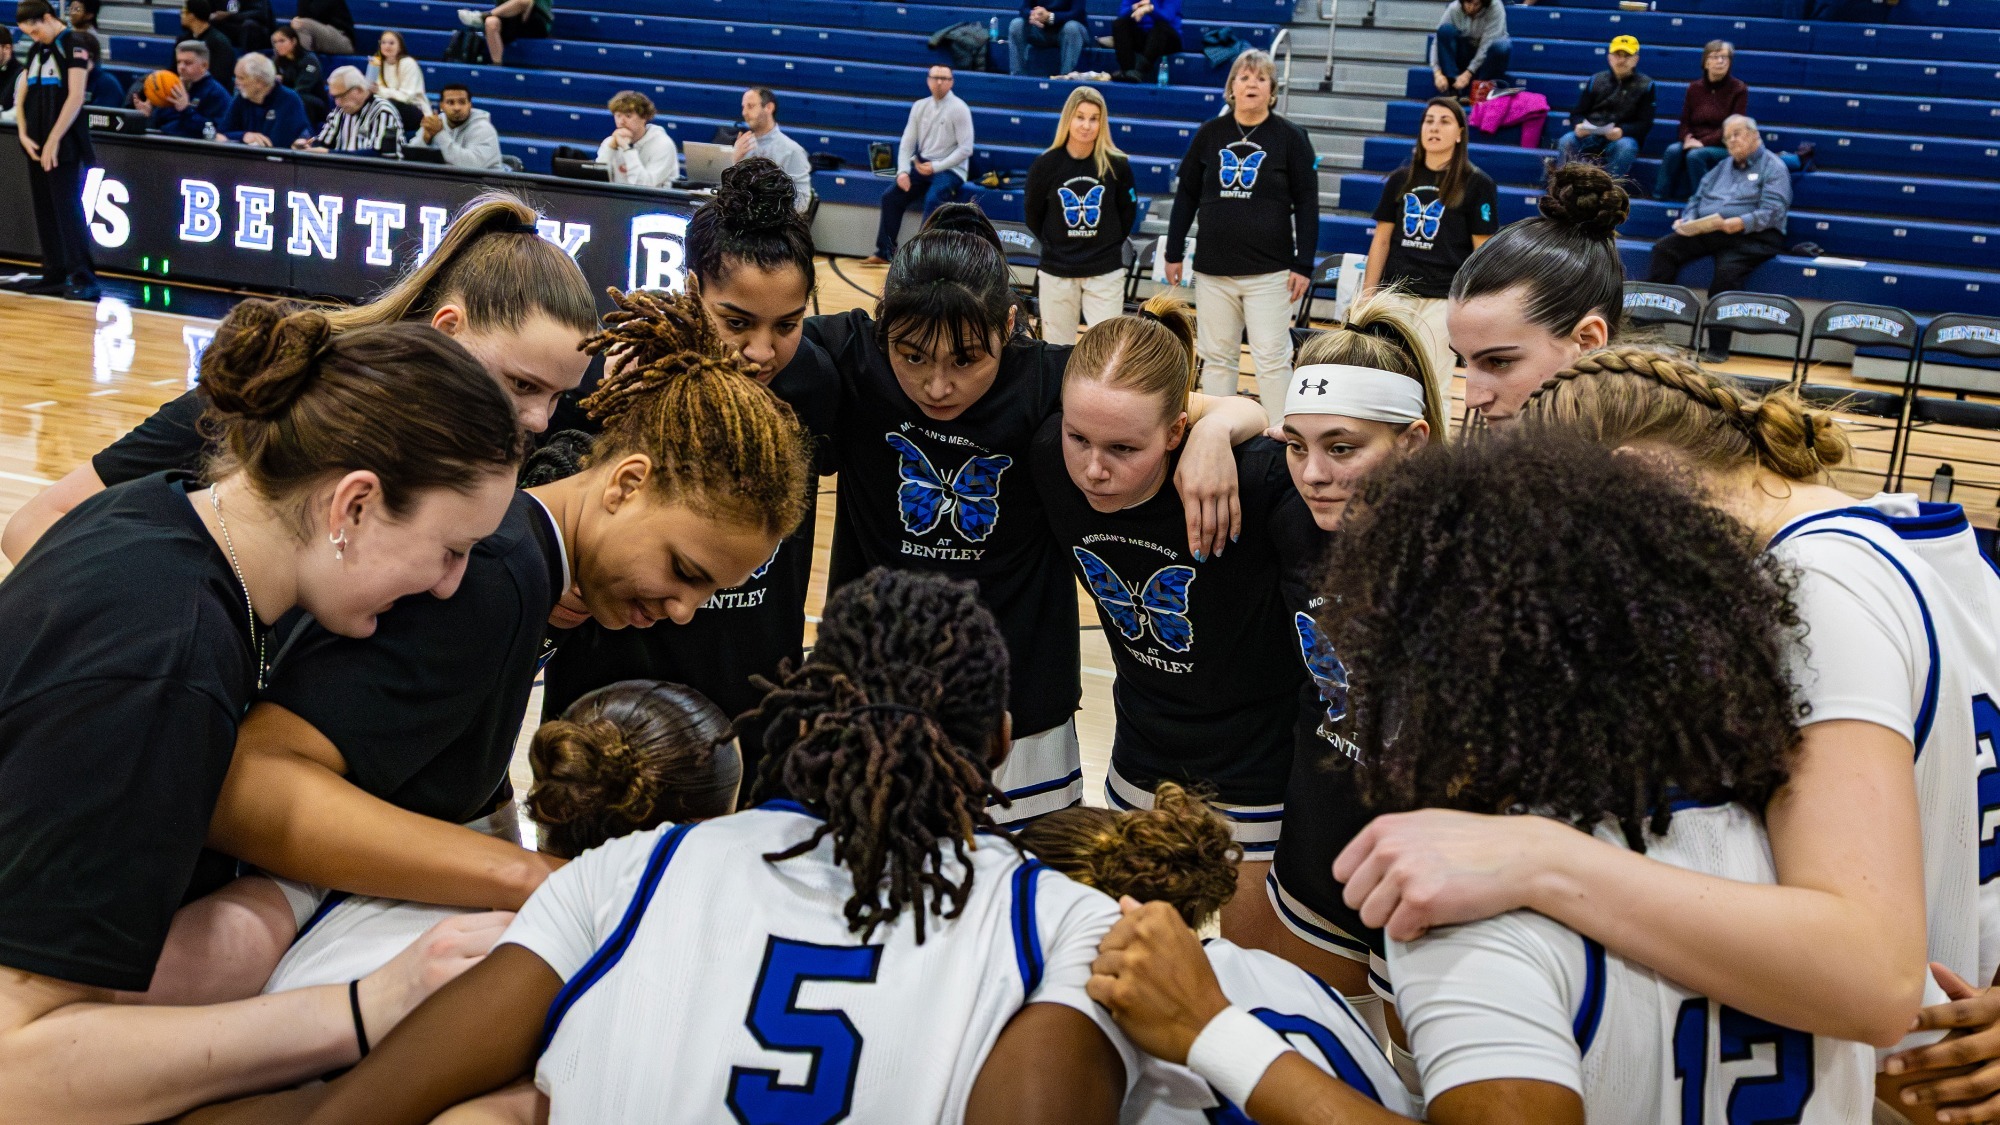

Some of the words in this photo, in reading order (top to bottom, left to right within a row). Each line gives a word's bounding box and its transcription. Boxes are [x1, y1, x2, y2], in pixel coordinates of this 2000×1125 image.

[179, 178, 591, 269] BENTLY
[996, 229, 1034, 249] NTLEY
[1623, 292, 1686, 315] ENTLEY
[1716, 303, 1791, 325] BENTLEY
[1827, 314, 1904, 338] BENTLEY
[1937, 325, 2000, 345] BENTL
[900, 540, 986, 561] BENTLEY
[937, 537, 952, 546] AT
[1082, 533, 1127, 546] MORGAN'S
[1128, 538, 1179, 560] MESSAGE
[699, 587, 767, 609] NTLEY
[1147, 646, 1159, 656] AT
[725, 934, 884, 1125] 5
[1673, 997, 1815, 1125] 12
